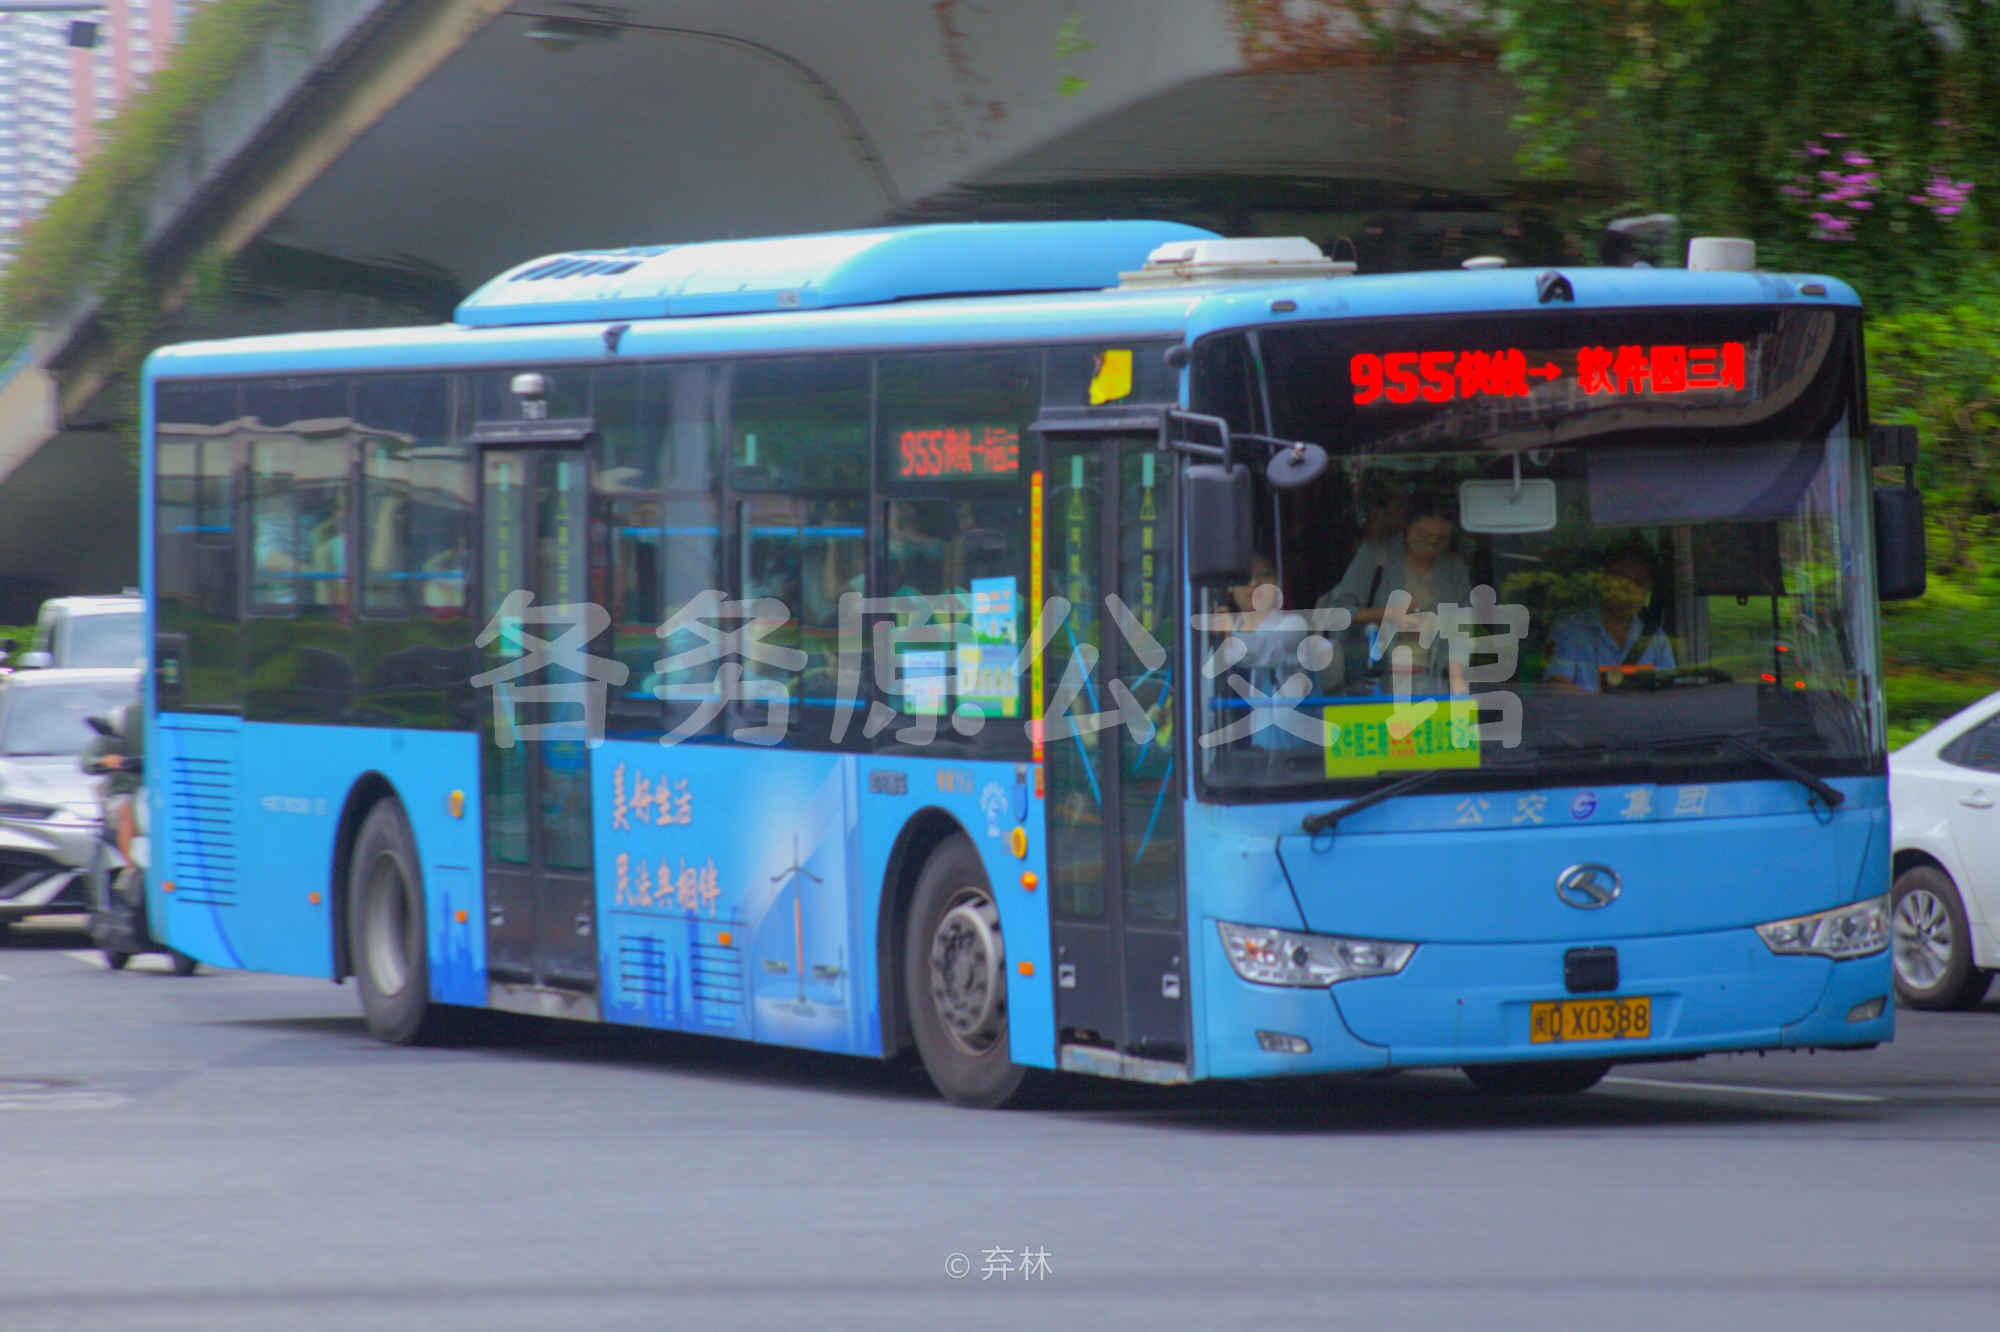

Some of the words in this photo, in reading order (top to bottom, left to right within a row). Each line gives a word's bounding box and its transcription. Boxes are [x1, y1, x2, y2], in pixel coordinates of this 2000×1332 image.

[613, 761, 693, 831] 美好生活
[1455, 793, 1548, 825] 公交
[1620, 785, 1710, 819] 集团
[615, 851, 722, 918] 民法典相伴
